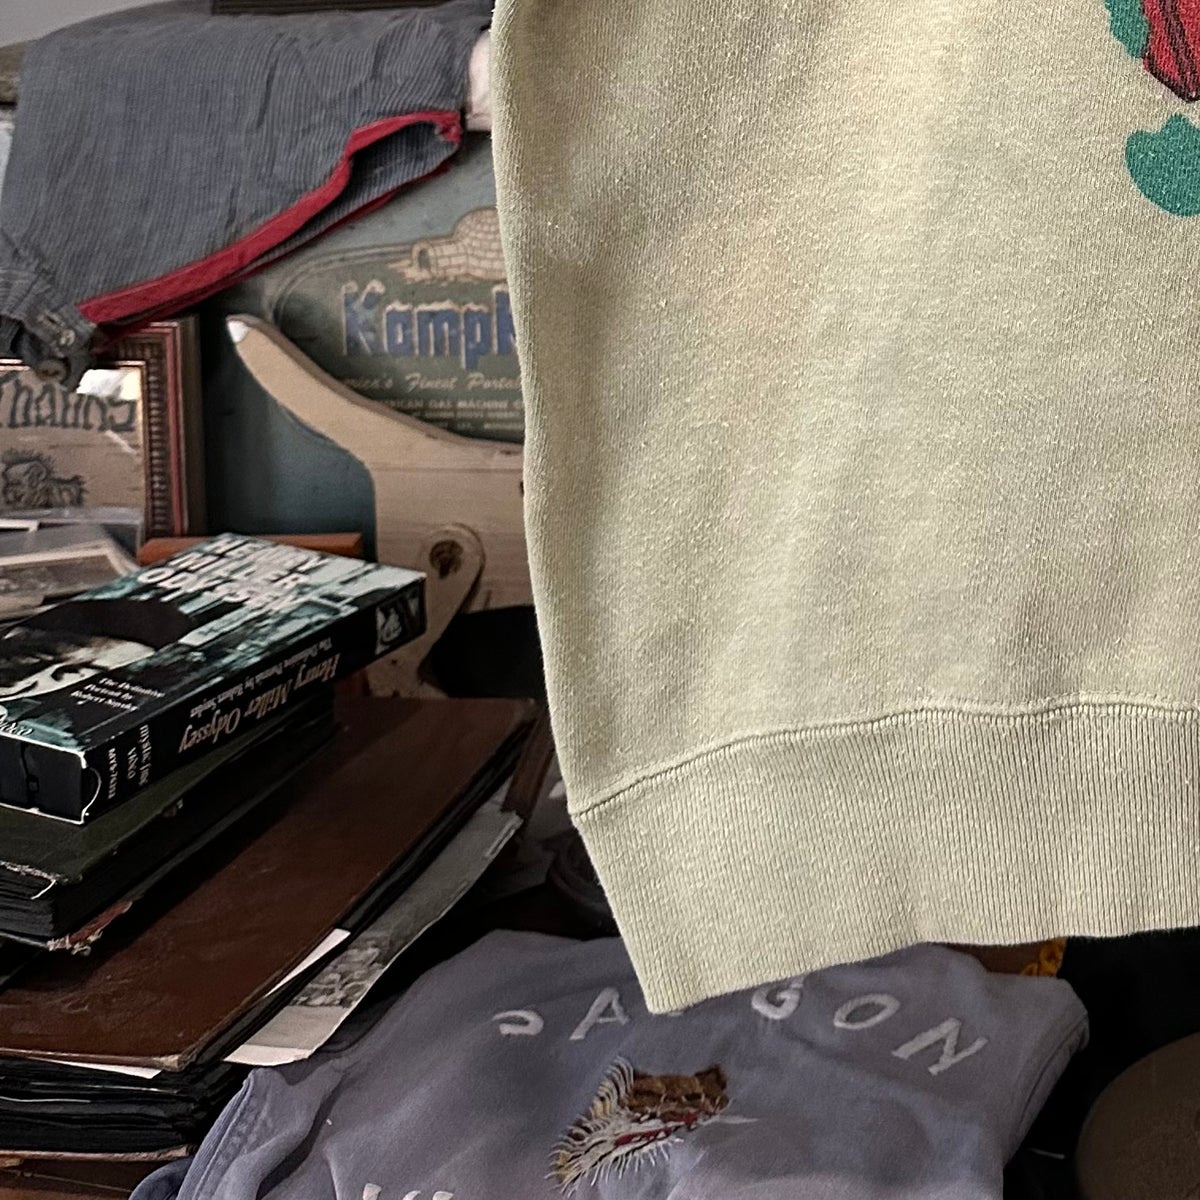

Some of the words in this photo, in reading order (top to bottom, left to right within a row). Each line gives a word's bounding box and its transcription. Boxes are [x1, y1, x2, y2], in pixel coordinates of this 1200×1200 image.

[293, 653, 340, 693] Henry
[243, 682, 291, 723] Miller
[179, 706, 240, 754] Odyssey
